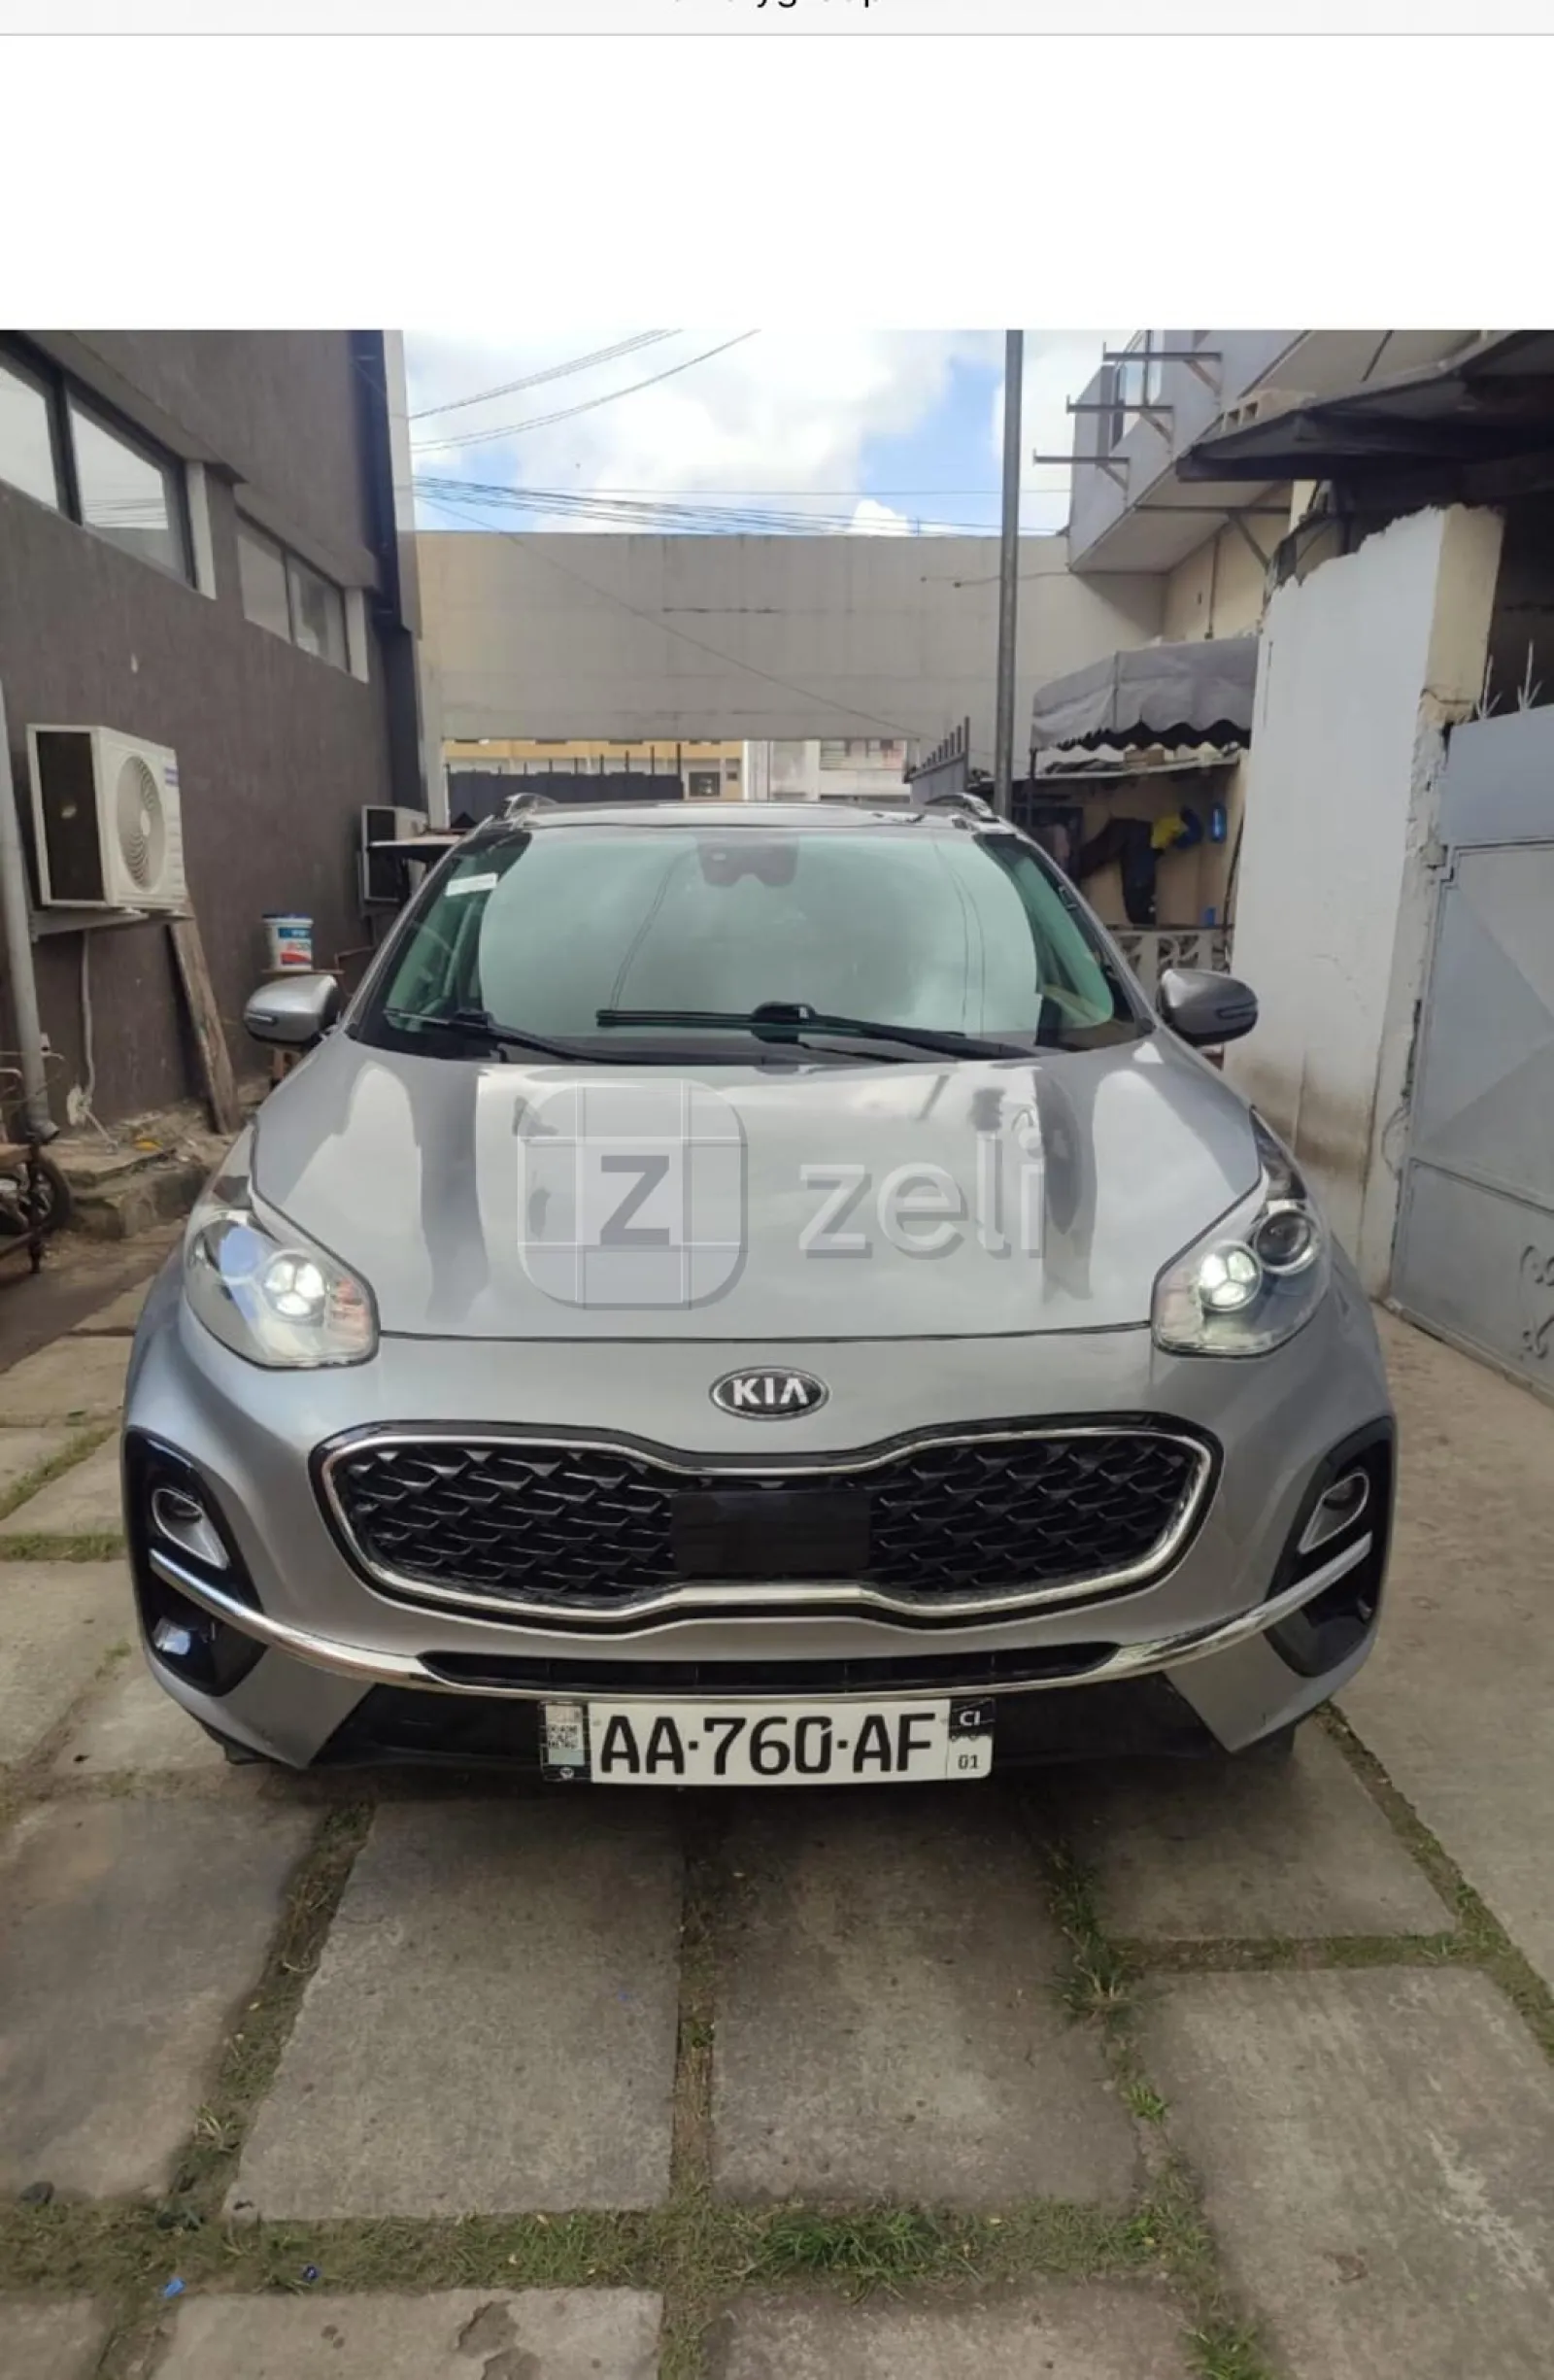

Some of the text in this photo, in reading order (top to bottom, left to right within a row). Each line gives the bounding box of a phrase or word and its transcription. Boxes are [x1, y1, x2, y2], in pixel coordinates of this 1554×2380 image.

[731, 1377, 808, 1406] KIA
[960, 1710, 981, 1726] CI
[957, 1753, 980, 1770] 01
